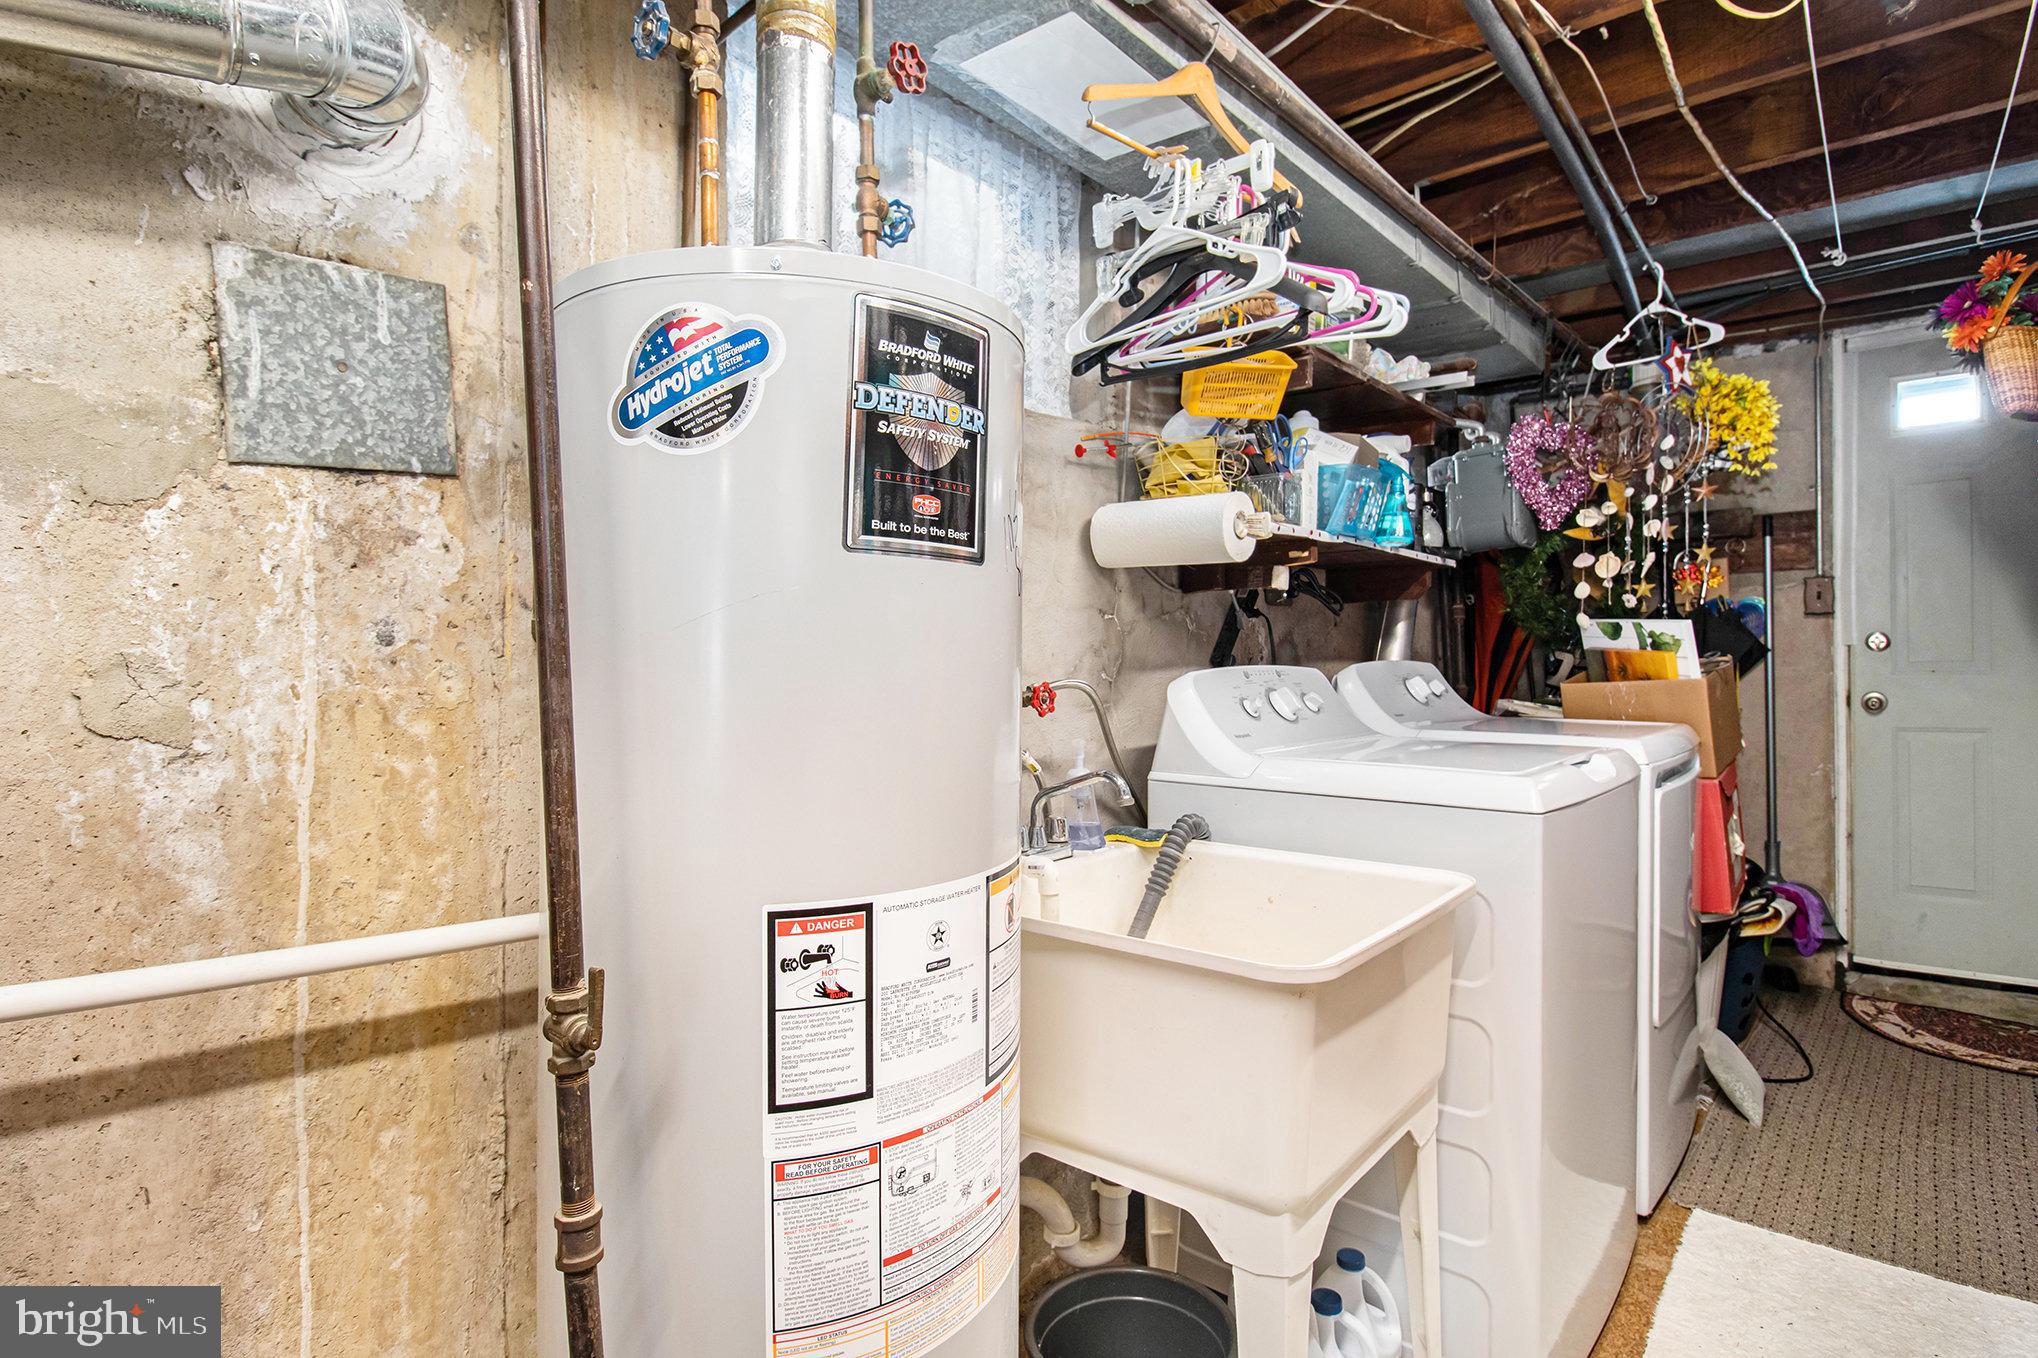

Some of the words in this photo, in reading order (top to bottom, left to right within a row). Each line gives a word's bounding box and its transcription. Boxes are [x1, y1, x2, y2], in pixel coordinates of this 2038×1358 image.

[644, 350, 688, 379] EQUIPPED
[694, 334, 718, 350] WITH
[715, 341, 733, 356] TOTAL
[716, 336, 761, 363] PERFORMANCE
[878, 340, 941, 363] BRADFORD
[943, 354, 975, 375] WHITE
[718, 354, 743, 371] SYSTEM
[886, 355, 967, 379] CORPORATION
[672, 383, 725, 414] FEATURING
[649, 430, 690, 447] BRADFORD
[695, 432, 721, 445] WHITE
[724, 376, 758, 432] CORPORATION
[681, 420, 696, 432] Lower
[695, 409, 719, 424] Operating
[717, 402, 732, 413] Costs
[855, 381, 985, 435] DEFENDER
[673, 411, 694, 427] Reduced
[691, 424, 705, 435] More
[703, 419, 714, 430] Hot
[712, 413, 728, 425] Water
[877, 421, 926, 439] SAFETY
[874, 471, 929, 484] ENERGY
[937, 480, 971, 494] SAVER
[871, 519, 897, 532] Built
[900, 522, 911, 532] to
[913, 524, 927, 535] be
[929, 526, 946, 537] the
[883, 901, 919, 913] AUTOMATIC
[920, 895, 945, 907] STORAGE
[947, 890, 963, 900] WATER
[807, 918, 855, 932] DANGER
[822, 969, 839, 977] HOT
[830, 991, 849, 999] BURN
[781, 1024, 802, 1032] instantly
[797, 1037, 816, 1045] highest
[800, 1055, 829, 1063] temperature
[826, 1066, 845, 1074] bathing
[805, 1166, 831, 1176] BEFORE
[832, 1158, 868, 1170] OPERATING
[813, 1160, 832, 1168] YOUR
[832, 1155, 857, 1165] SAFETY
[829, 1330, 848, 1339] STATUS
